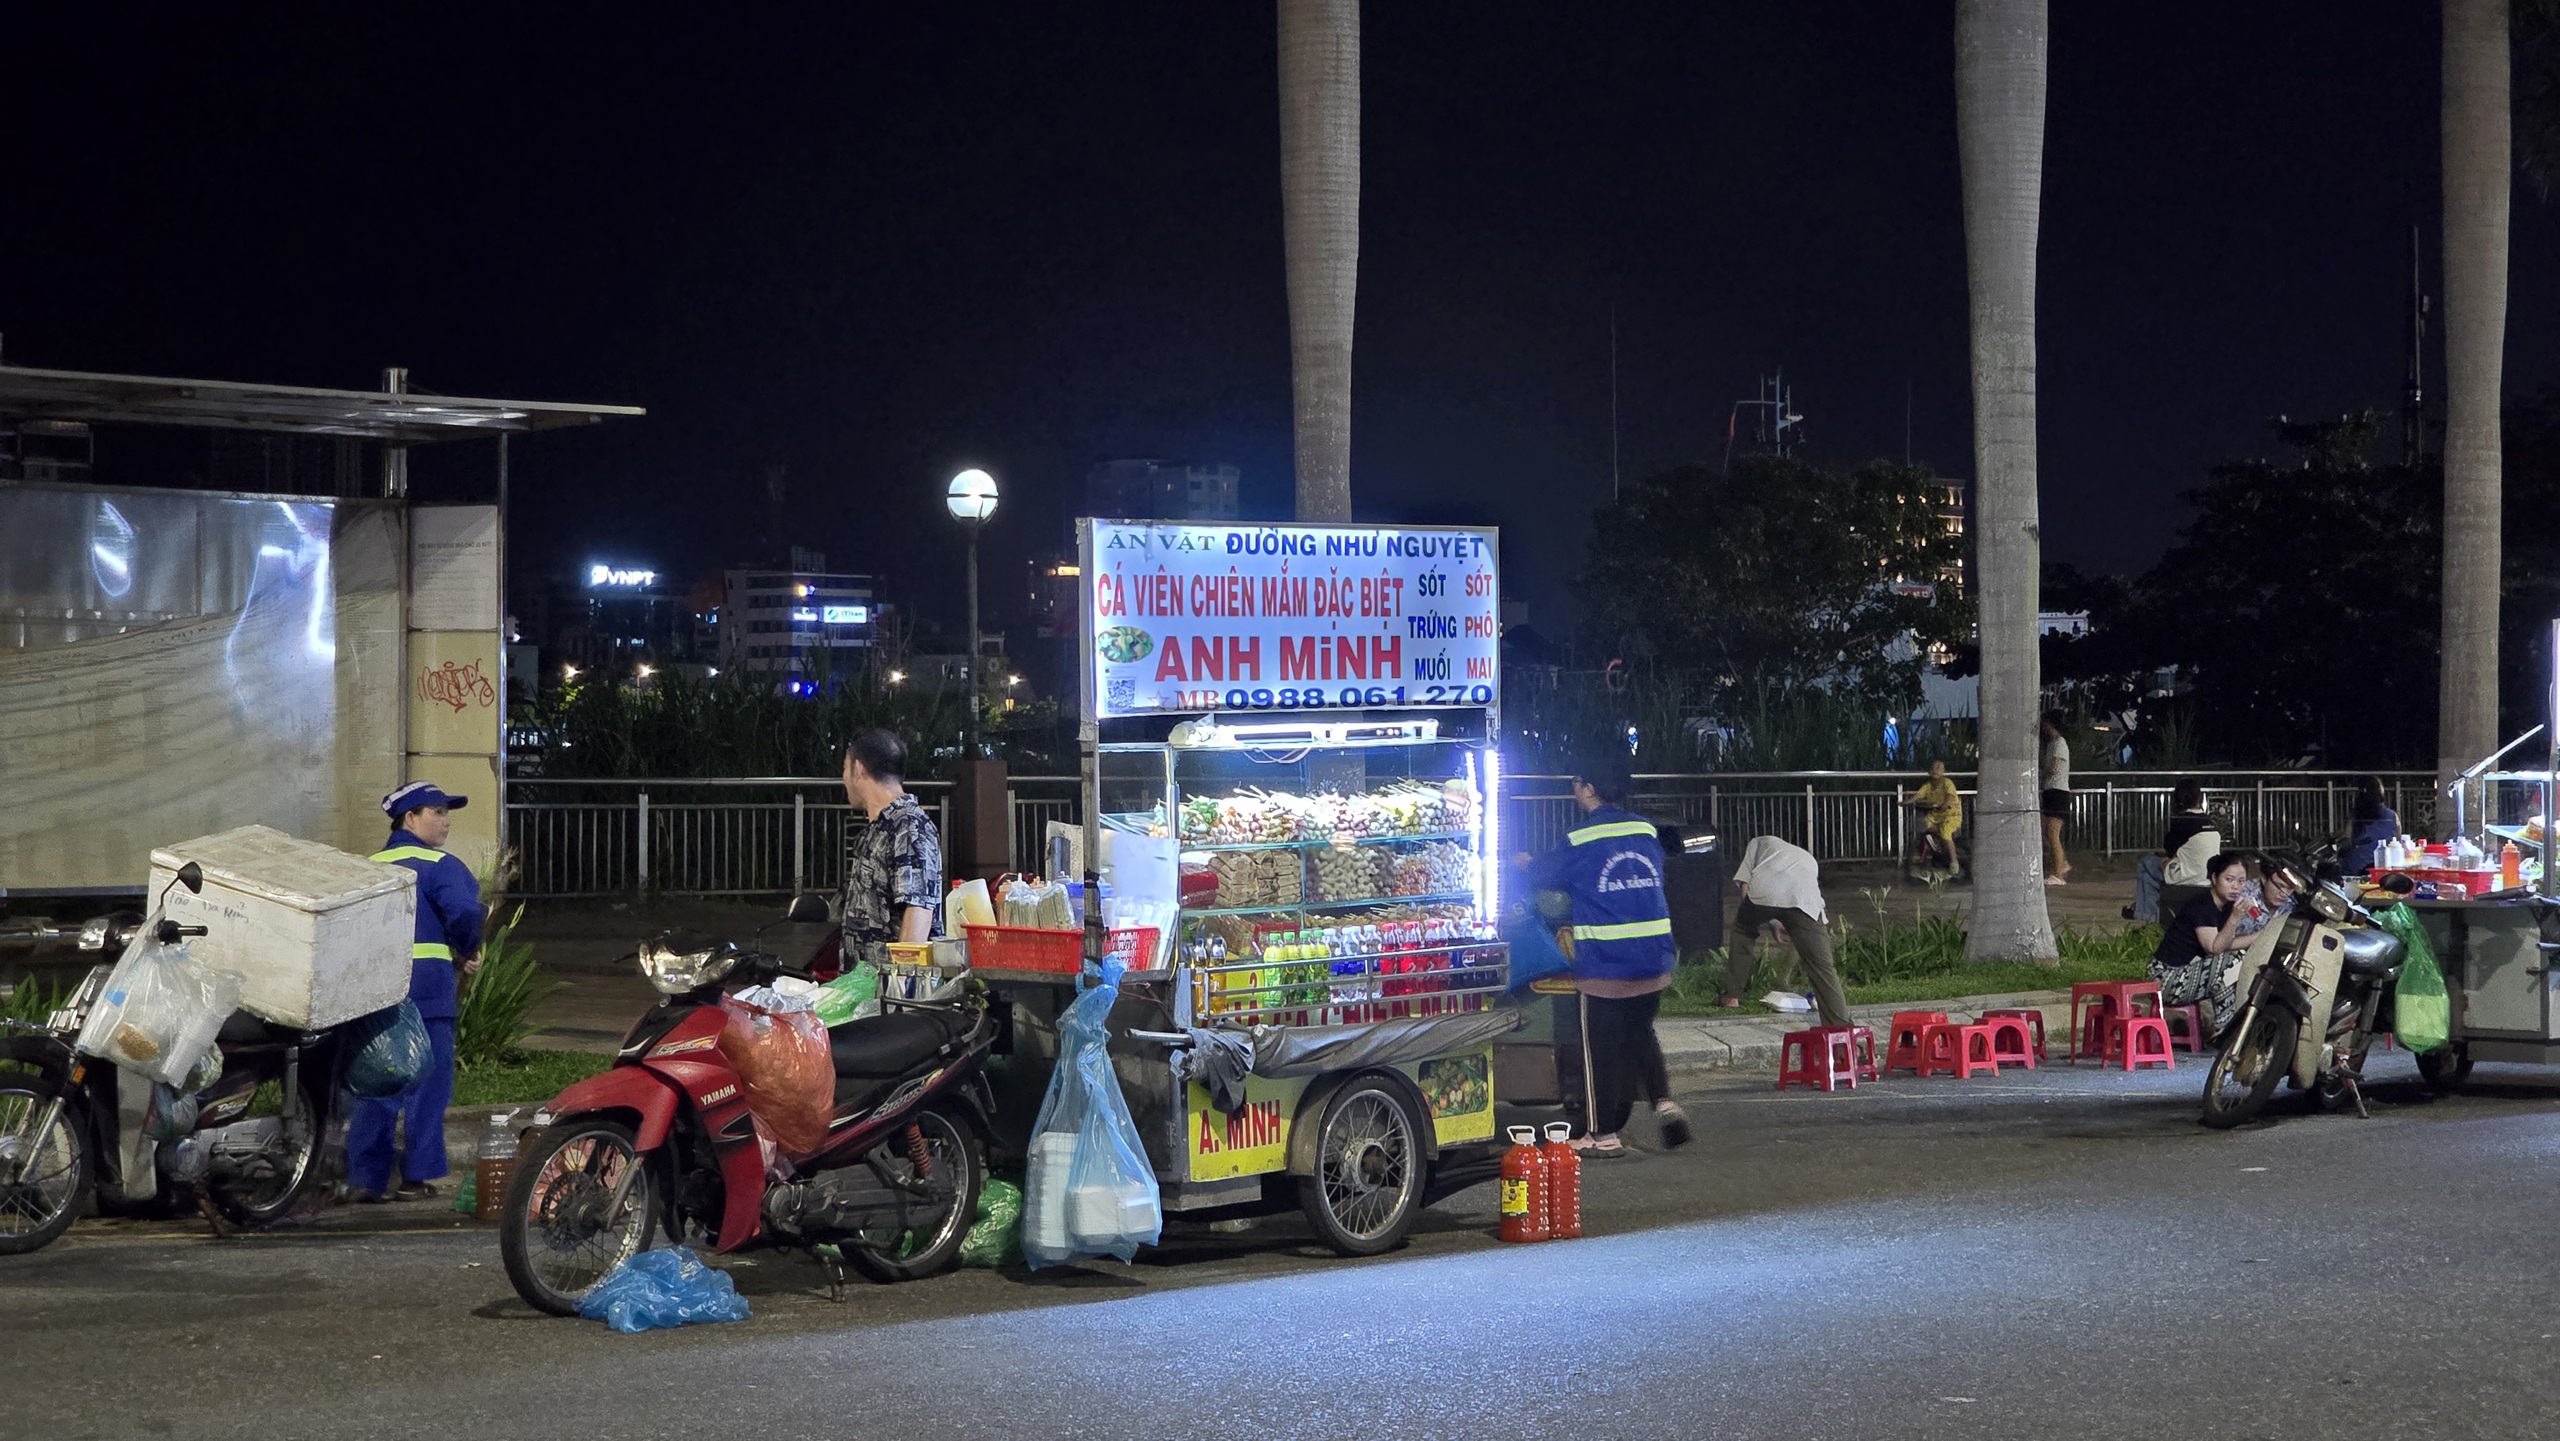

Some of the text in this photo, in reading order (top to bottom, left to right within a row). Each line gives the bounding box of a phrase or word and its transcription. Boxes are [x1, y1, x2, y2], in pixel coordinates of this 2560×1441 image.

[1107, 527, 1484, 564] ĂN VẶT ĐƯỜNG NHƯ NGUYỆT
[608, 571, 655, 585] VNPT
[1098, 558, 1404, 630] CÁ VIÊN CHIÊN MẮM ĐẶC BIỆT
[1418, 564, 1447, 597] SỐT
[1465, 564, 1492, 597] SỐT
[1408, 609, 1457, 639] TRỨNG
[1465, 610, 1493, 639] PHÔ
[1155, 636, 1260, 682] ANH
[1415, 648, 1451, 681] MUỐI
[1467, 657, 1492, 679] MAI
[1174, 685, 1493, 711] MB 0988.061.270
[700, 1084, 736, 1106] YAMAHA
[1199, 1099, 1281, 1155] A. MINH
